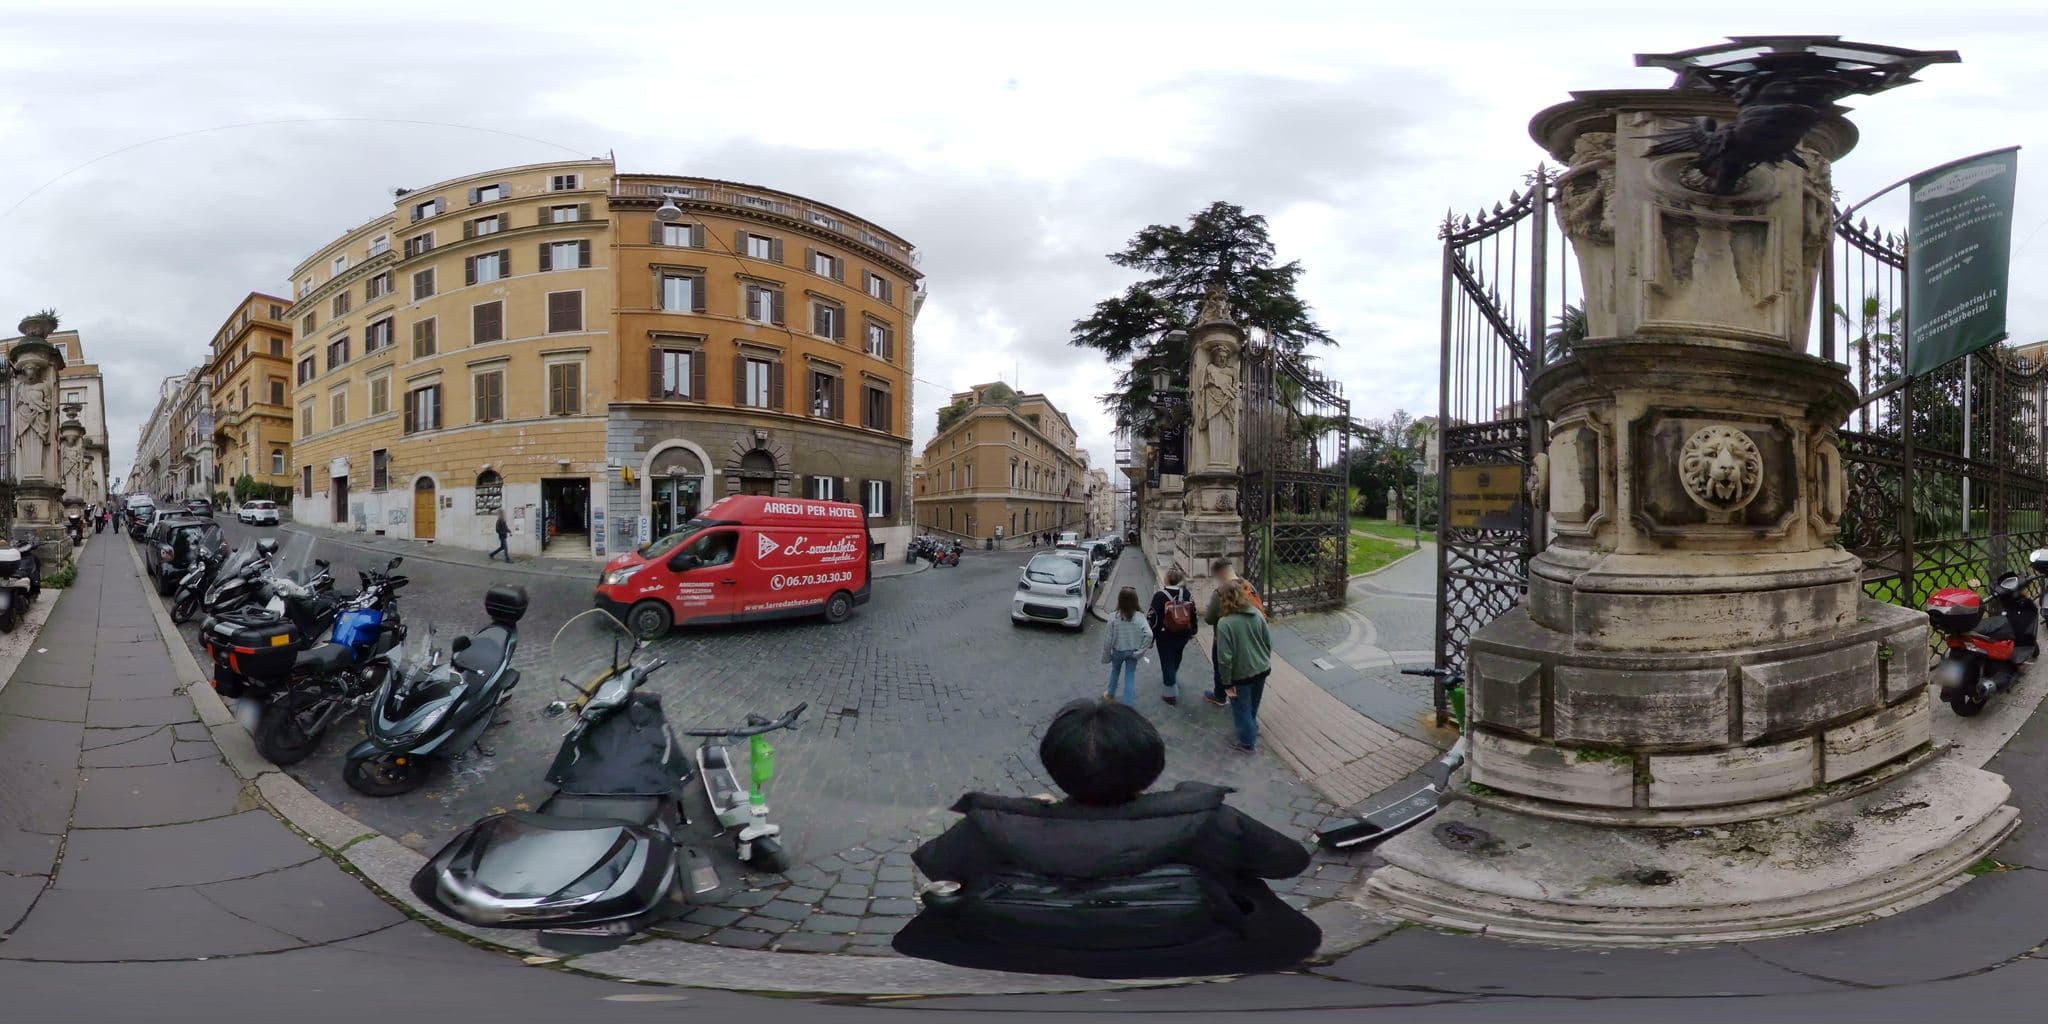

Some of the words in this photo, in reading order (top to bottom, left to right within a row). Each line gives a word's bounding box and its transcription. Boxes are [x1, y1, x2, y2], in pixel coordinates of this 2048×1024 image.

[1912, 288, 1998, 337] www.serrebarberini.it
[763, 501, 804, 516] ARREDI
[807, 505, 826, 517] PER
[828, 506, 858, 519] HOTEL
[786, 571, 852, 587] 06.70.30.30.30
[744, 597, 823, 611] www.larredatheta.com
